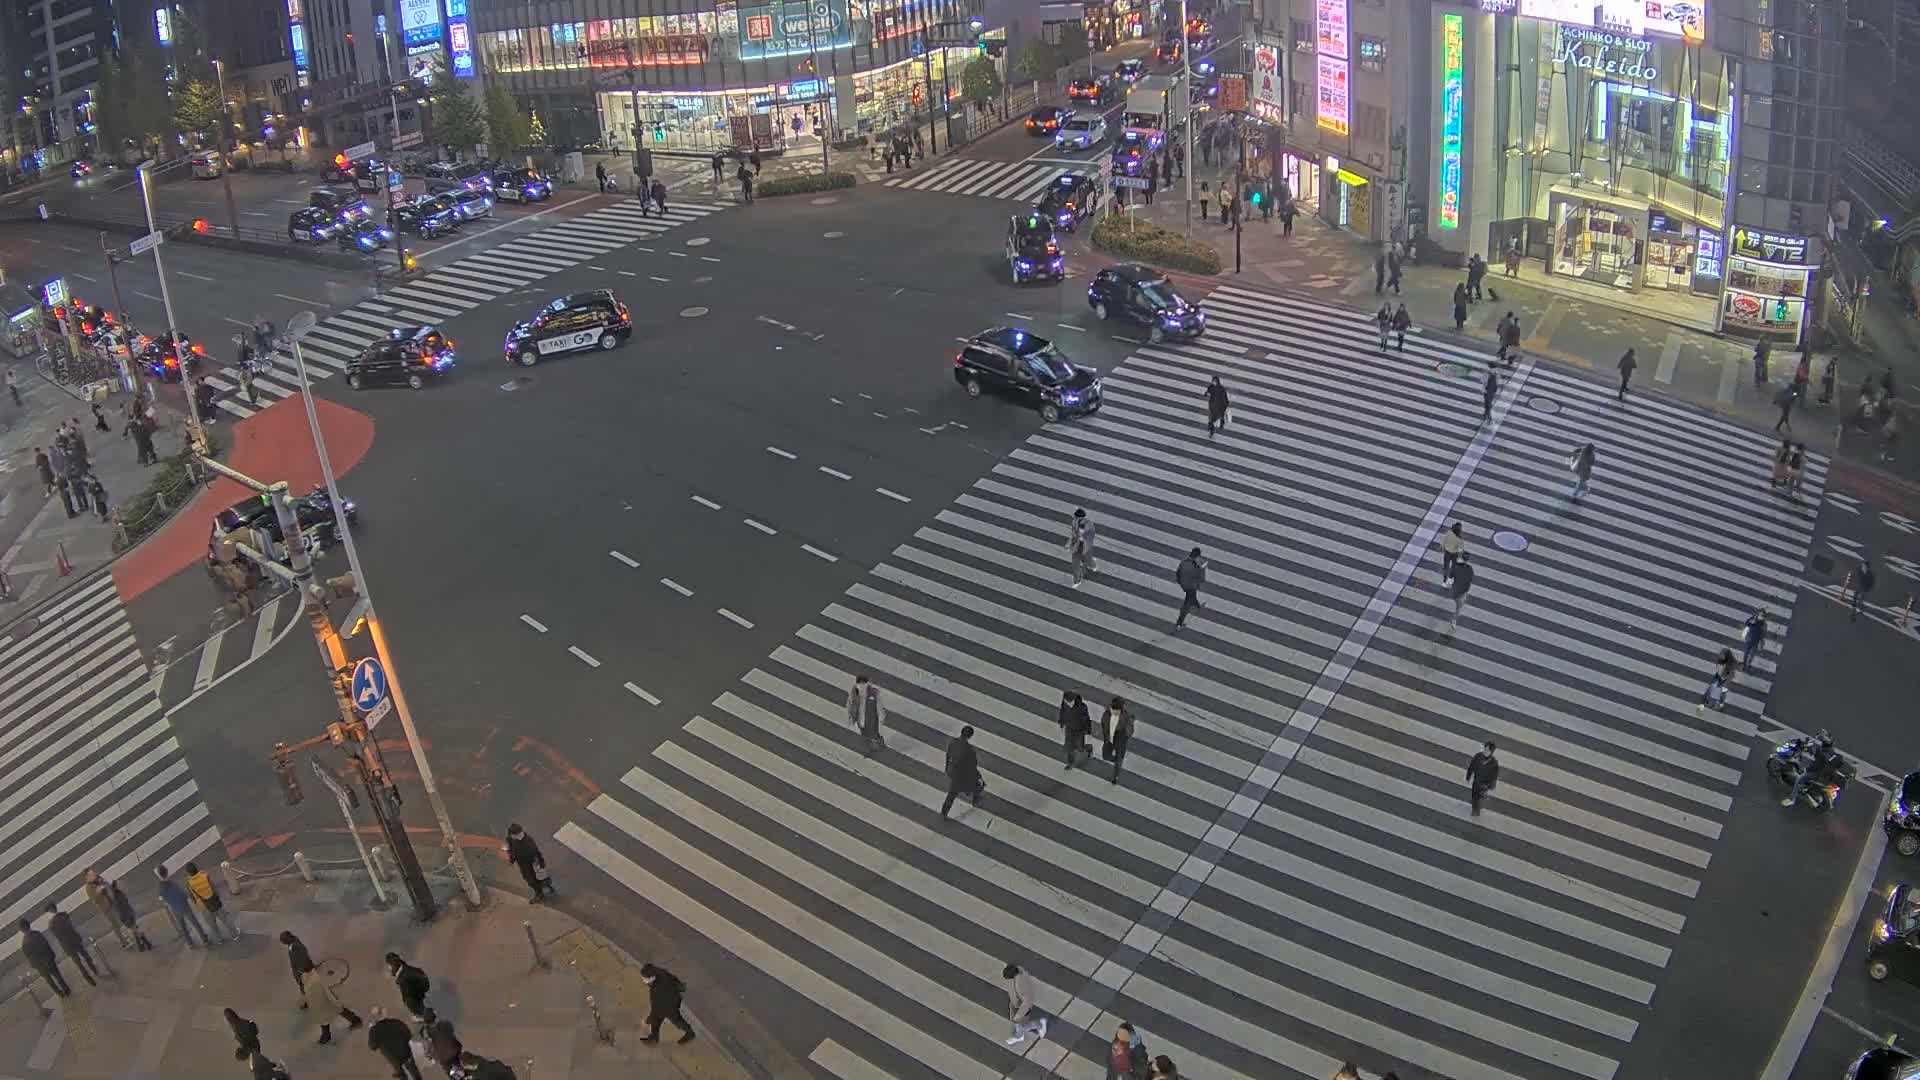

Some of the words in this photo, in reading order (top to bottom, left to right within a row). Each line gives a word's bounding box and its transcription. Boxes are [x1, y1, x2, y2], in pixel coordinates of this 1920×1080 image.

[1558, 25, 1613, 44] PACHINKO
[1615, 36, 1624, 48] &
[1625, 38, 1653, 52] SLOT
[1552, 40, 1657, 80] Kaleido
